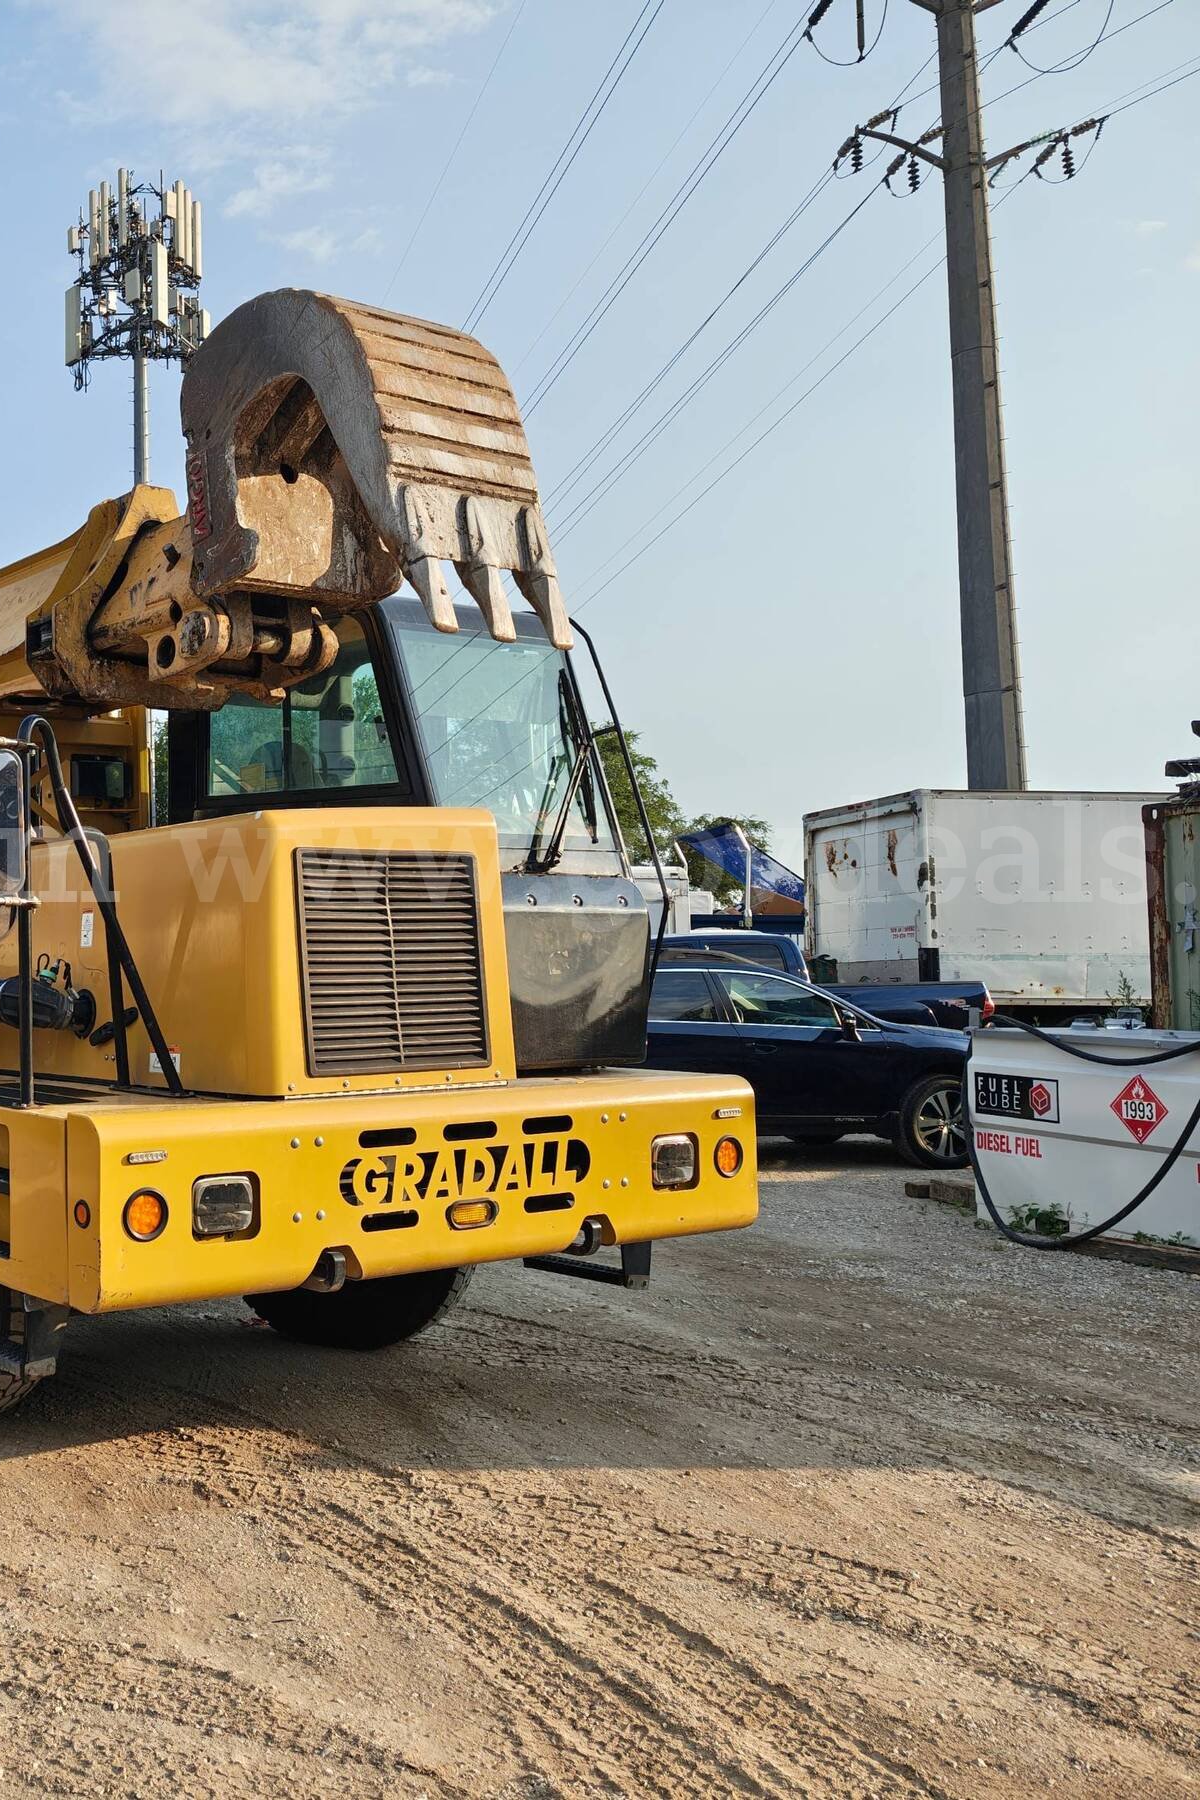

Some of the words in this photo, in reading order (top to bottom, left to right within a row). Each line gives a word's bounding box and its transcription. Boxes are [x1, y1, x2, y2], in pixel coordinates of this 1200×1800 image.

[977, 1076, 1021, 1095] FUEL
[978, 1091, 1022, 1110] CUBE
[1124, 1100, 1154, 1121] 1993
[1137, 1127, 1143, 1138] 3
[976, 1131, 1012, 1154] DIESEL
[1015, 1136, 1042, 1158] FUEL
[351, 1140, 579, 1207] GRADALL
